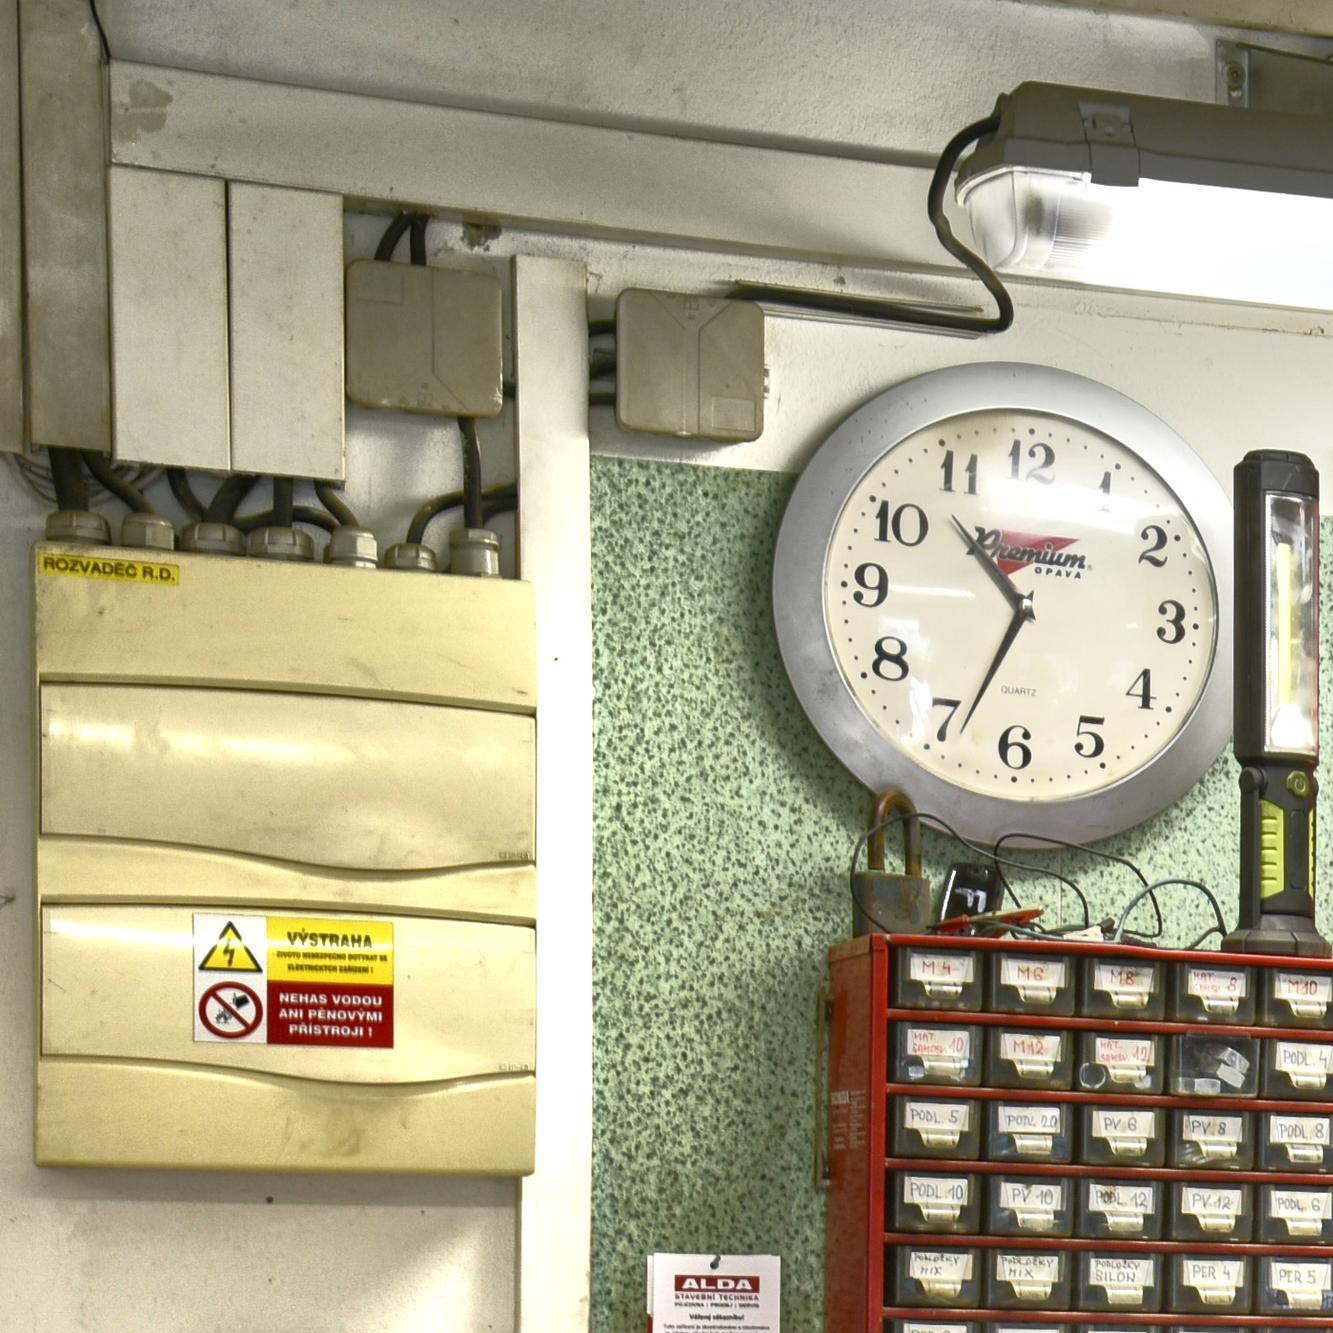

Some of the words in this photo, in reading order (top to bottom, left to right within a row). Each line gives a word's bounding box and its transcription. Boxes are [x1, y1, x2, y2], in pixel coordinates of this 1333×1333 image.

[939, 450, 980, 496] 11
[1007, 440, 1056, 486] 12
[874, 500, 929, 547] 10
[975, 526, 1086, 570] Premium
[1138, 525, 1168, 567] 2
[142, 565, 176, 582] R.D.
[853, 563, 889, 608] 9
[1034, 566, 1082, 580] OPAVA
[1156, 600, 1186, 645] 3
[871, 636, 910, 682] 8
[1001, 686, 1037, 697] QUARTZ
[1125, 669, 1157, 710] 4
[931, 697, 962, 743] 7
[1074, 715, 1106, 759] 5
[998, 725, 1033, 770] 6
[286, 928, 373, 949] VÝSTRAHA
[279, 992, 328, 1005] NEHAS
[331, 994, 383, 1006] VODOU
[279, 1008, 304, 1019] ANI
[289, 1022, 364, 1037] PŘÍSTROJI
[1315, 1123, 1325, 1139] 8
[681, 1277, 753, 1290] ALDA
